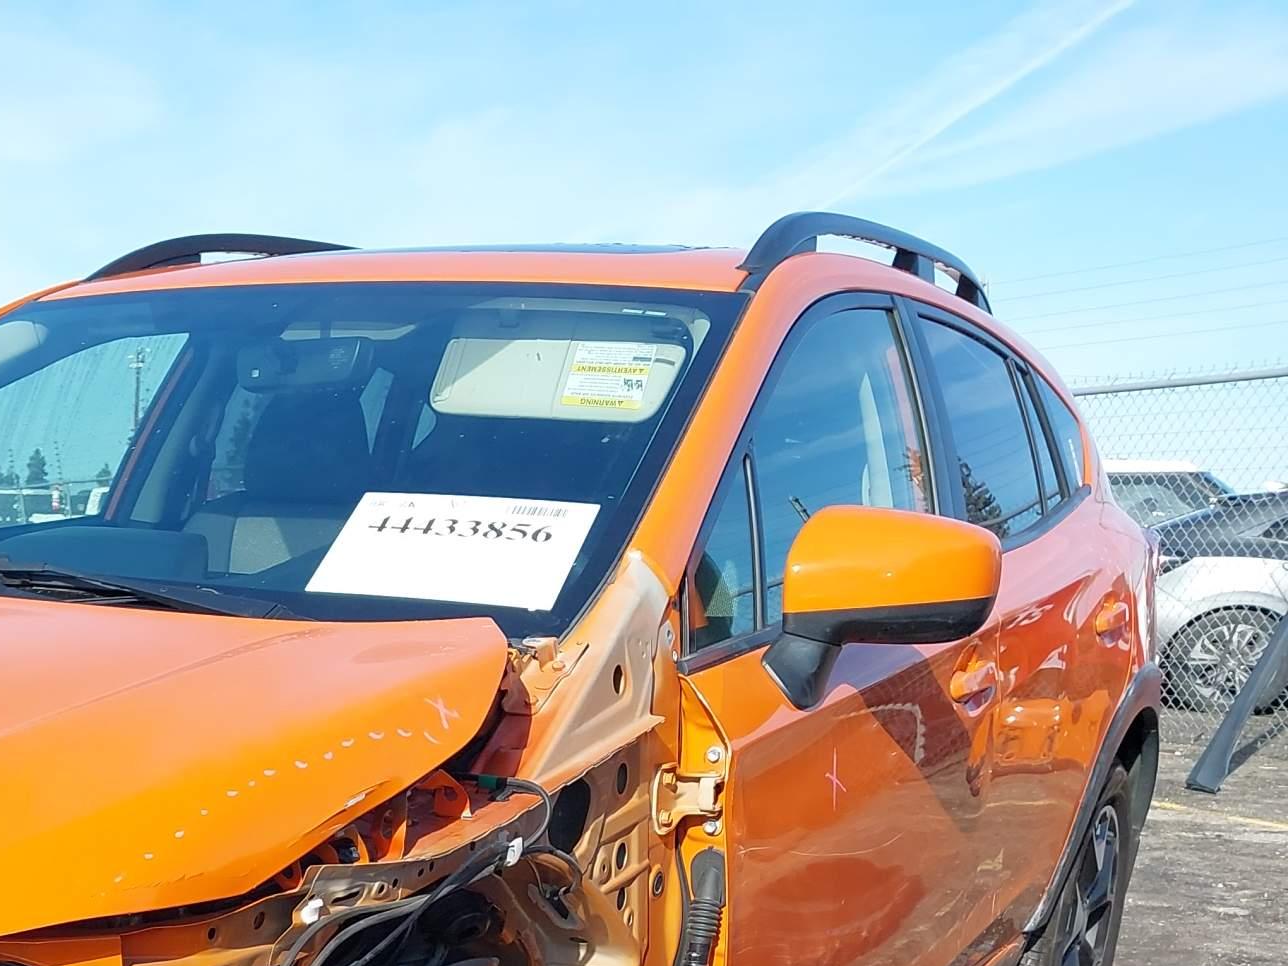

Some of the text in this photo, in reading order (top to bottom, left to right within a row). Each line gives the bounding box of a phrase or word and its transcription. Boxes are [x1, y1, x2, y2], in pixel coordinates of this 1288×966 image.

[576, 365, 638, 376] AVERTISSEMENT
[579, 397, 616, 406] WARNING
[367, 515, 553, 543] 44433856
